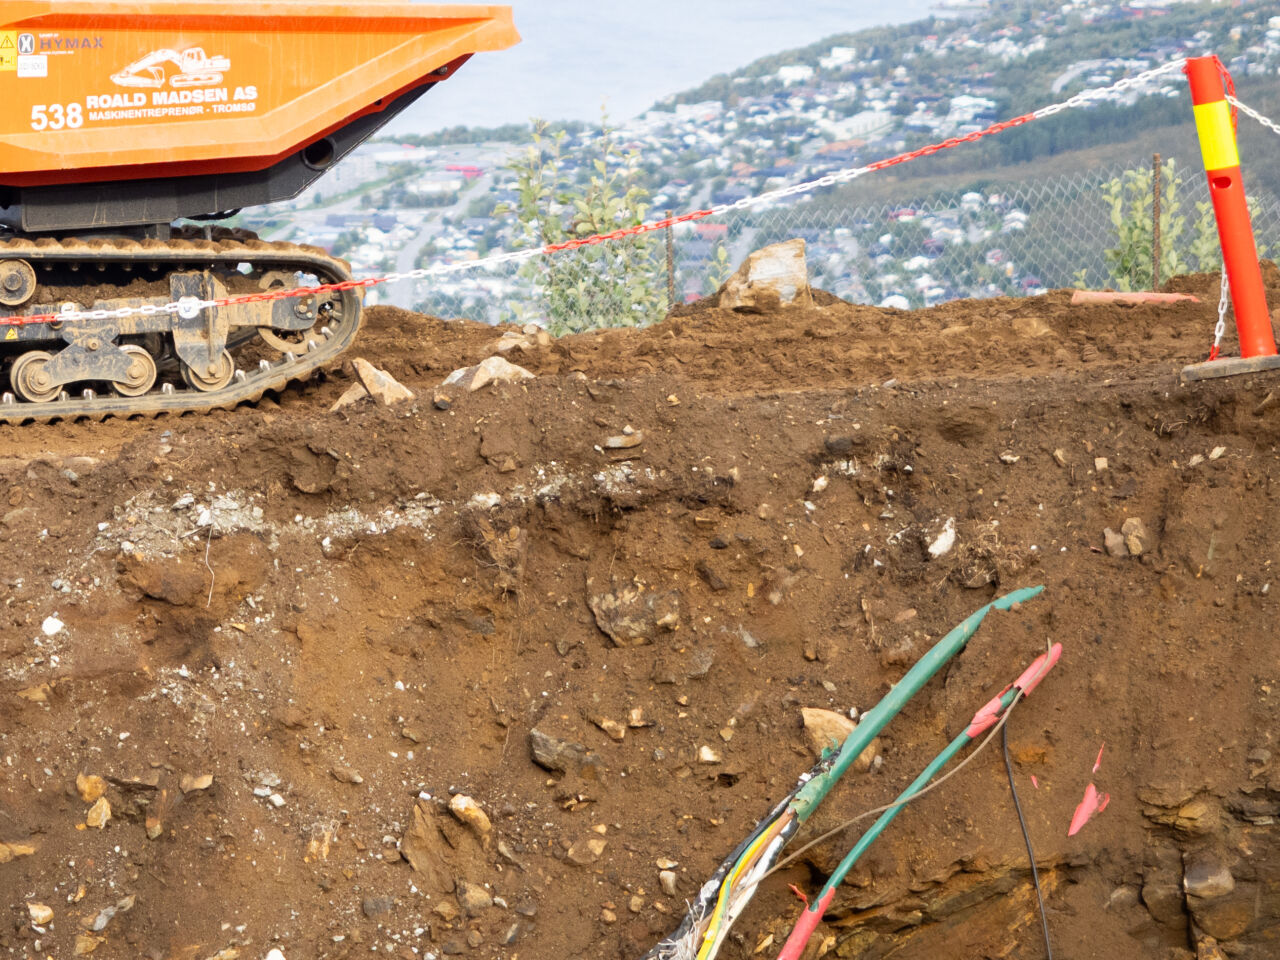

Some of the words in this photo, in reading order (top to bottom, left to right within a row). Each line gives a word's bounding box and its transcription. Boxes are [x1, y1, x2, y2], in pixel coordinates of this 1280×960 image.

[40, 37, 104, 50] HYMAX
[86, 93, 147, 110] ROALD
[152, 88, 228, 106] MADSEN
[233, 86, 258, 100] AS
[30, 103, 83, 131] 538
[89, 106, 204, 121] MASKINENTREPRENØR
[212, 102, 256, 114] TROMSØ
